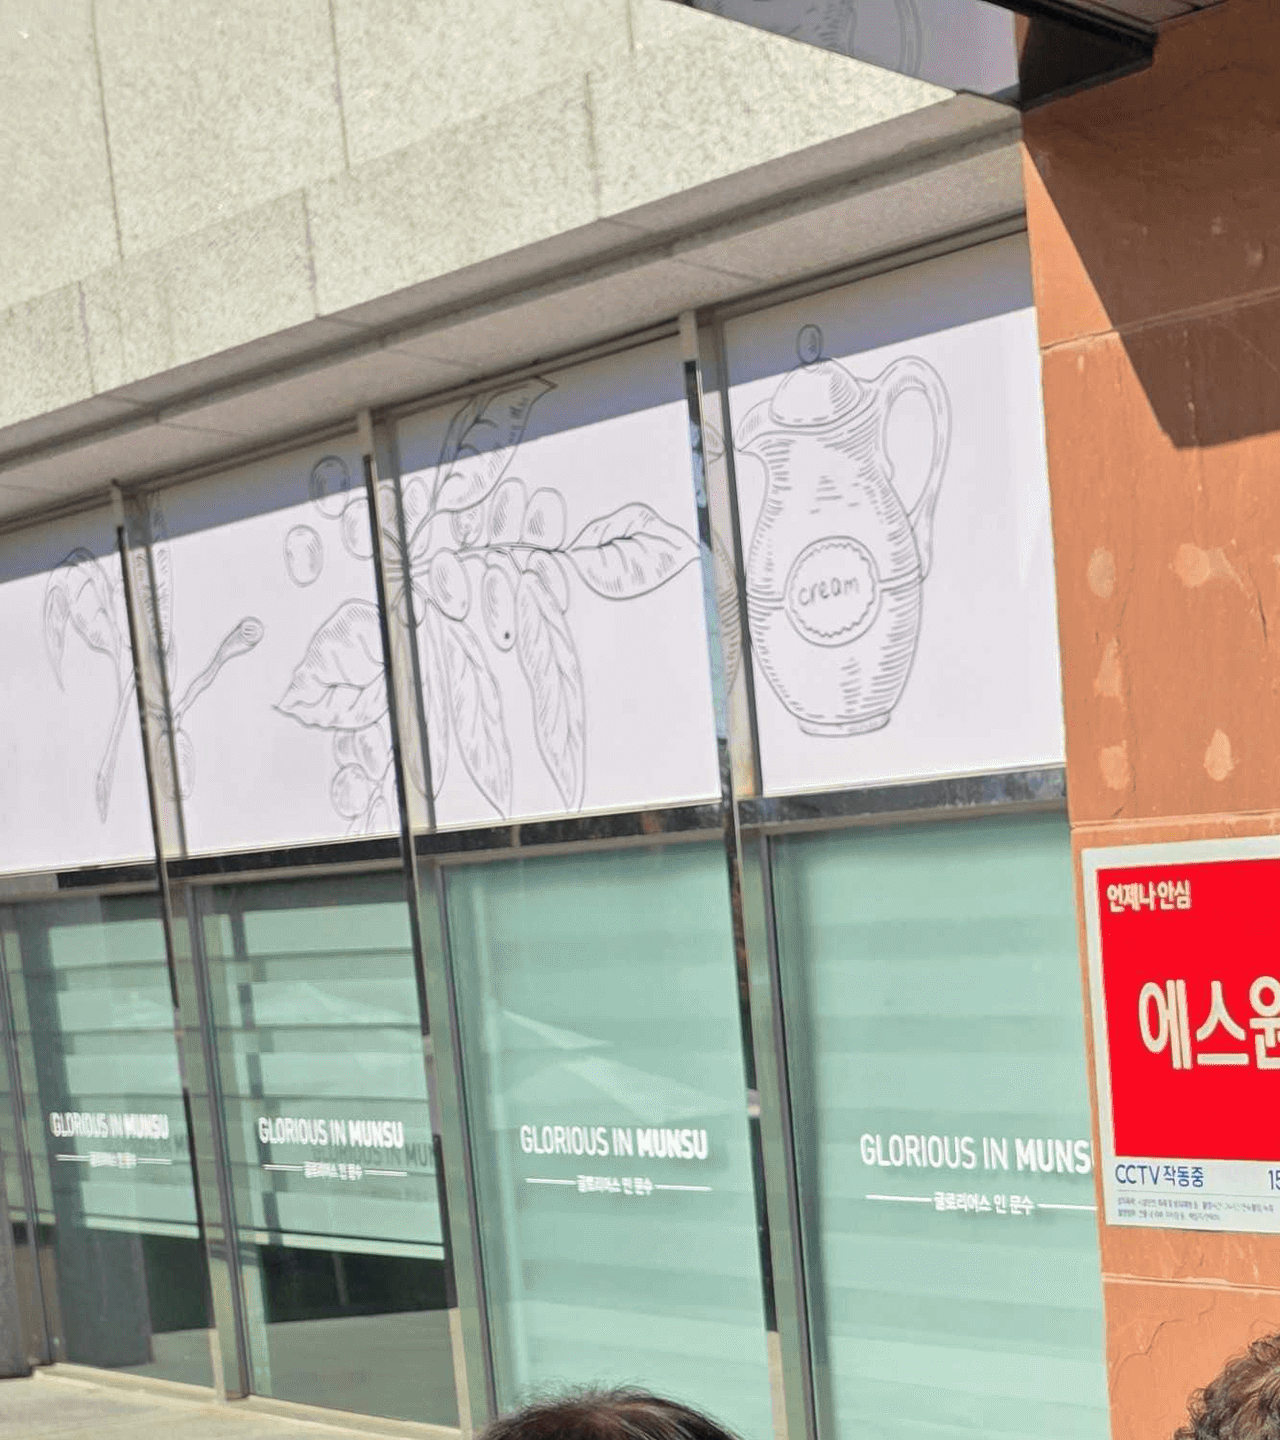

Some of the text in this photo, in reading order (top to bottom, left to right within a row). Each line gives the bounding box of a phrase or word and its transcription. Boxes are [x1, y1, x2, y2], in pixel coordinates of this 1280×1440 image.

[799, 577, 860, 606] cream
[1107, 880, 1192, 913] 언제나 안심
[50, 1111, 170, 1140] GLORIOUS IN MUNSU
[258, 1116, 405, 1149] GLORIOUS IN MUNSU
[520, 1124, 709, 1160] GLORIOUS IN MUNSU
[860, 1133, 1094, 1175] GLORIOUS IN MUNS
[1115, 1163, 1161, 1185] CCTV
[1162, 1165, 1205, 1188] 작동중
[994, 1194, 1008, 1215] 인
[1009, 1194, 1035, 1216] 문수
